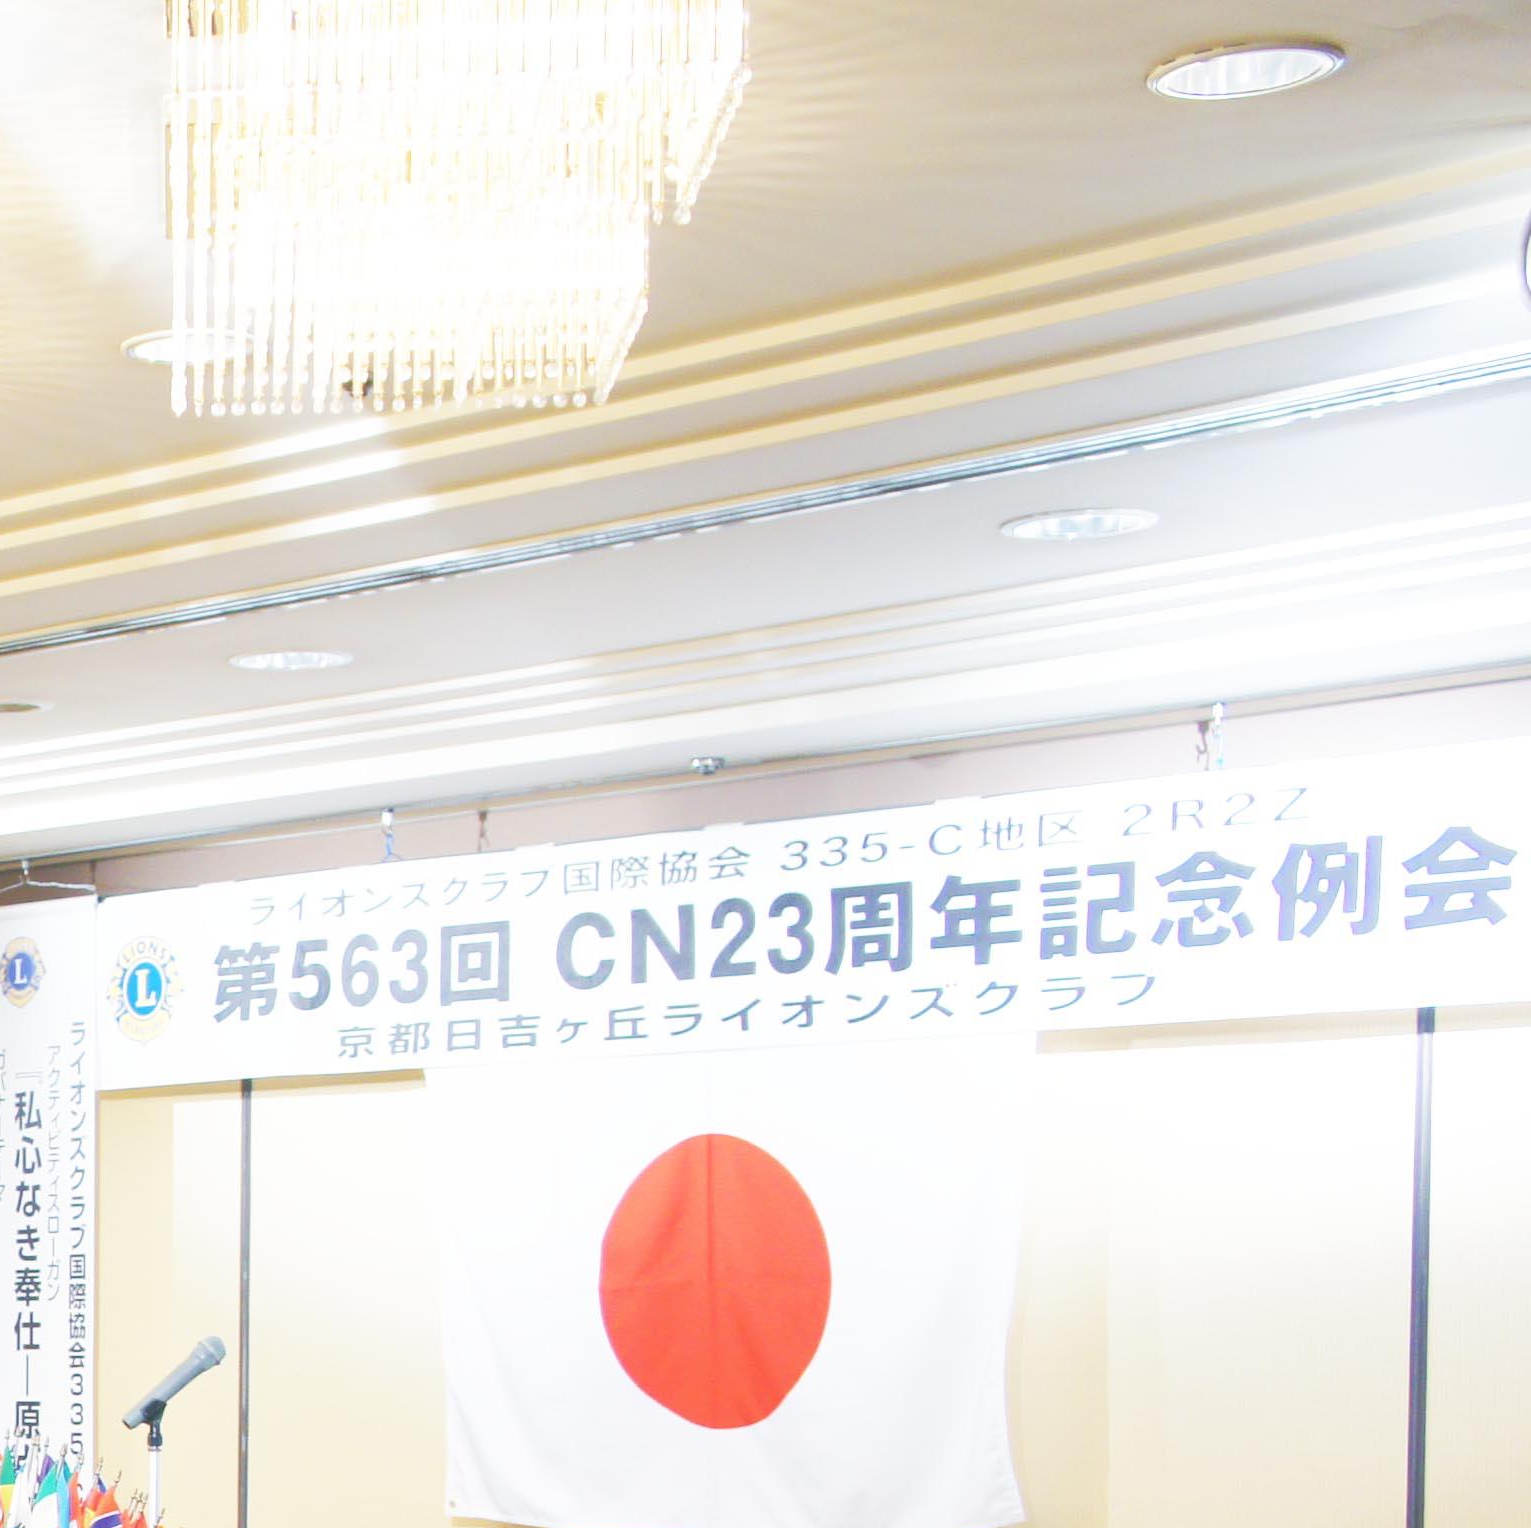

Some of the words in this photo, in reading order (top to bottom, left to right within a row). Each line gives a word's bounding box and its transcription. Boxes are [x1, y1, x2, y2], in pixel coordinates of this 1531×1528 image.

[1123, 787, 1308, 836] 2R2Z
[213, 920, 510, 1022] 第563回
[556, 826, 1518, 990] CN23周年記念例会
[134, 968, 157, 1008] L
[47, 1045, 61, 1302] アクティビティスローガン
